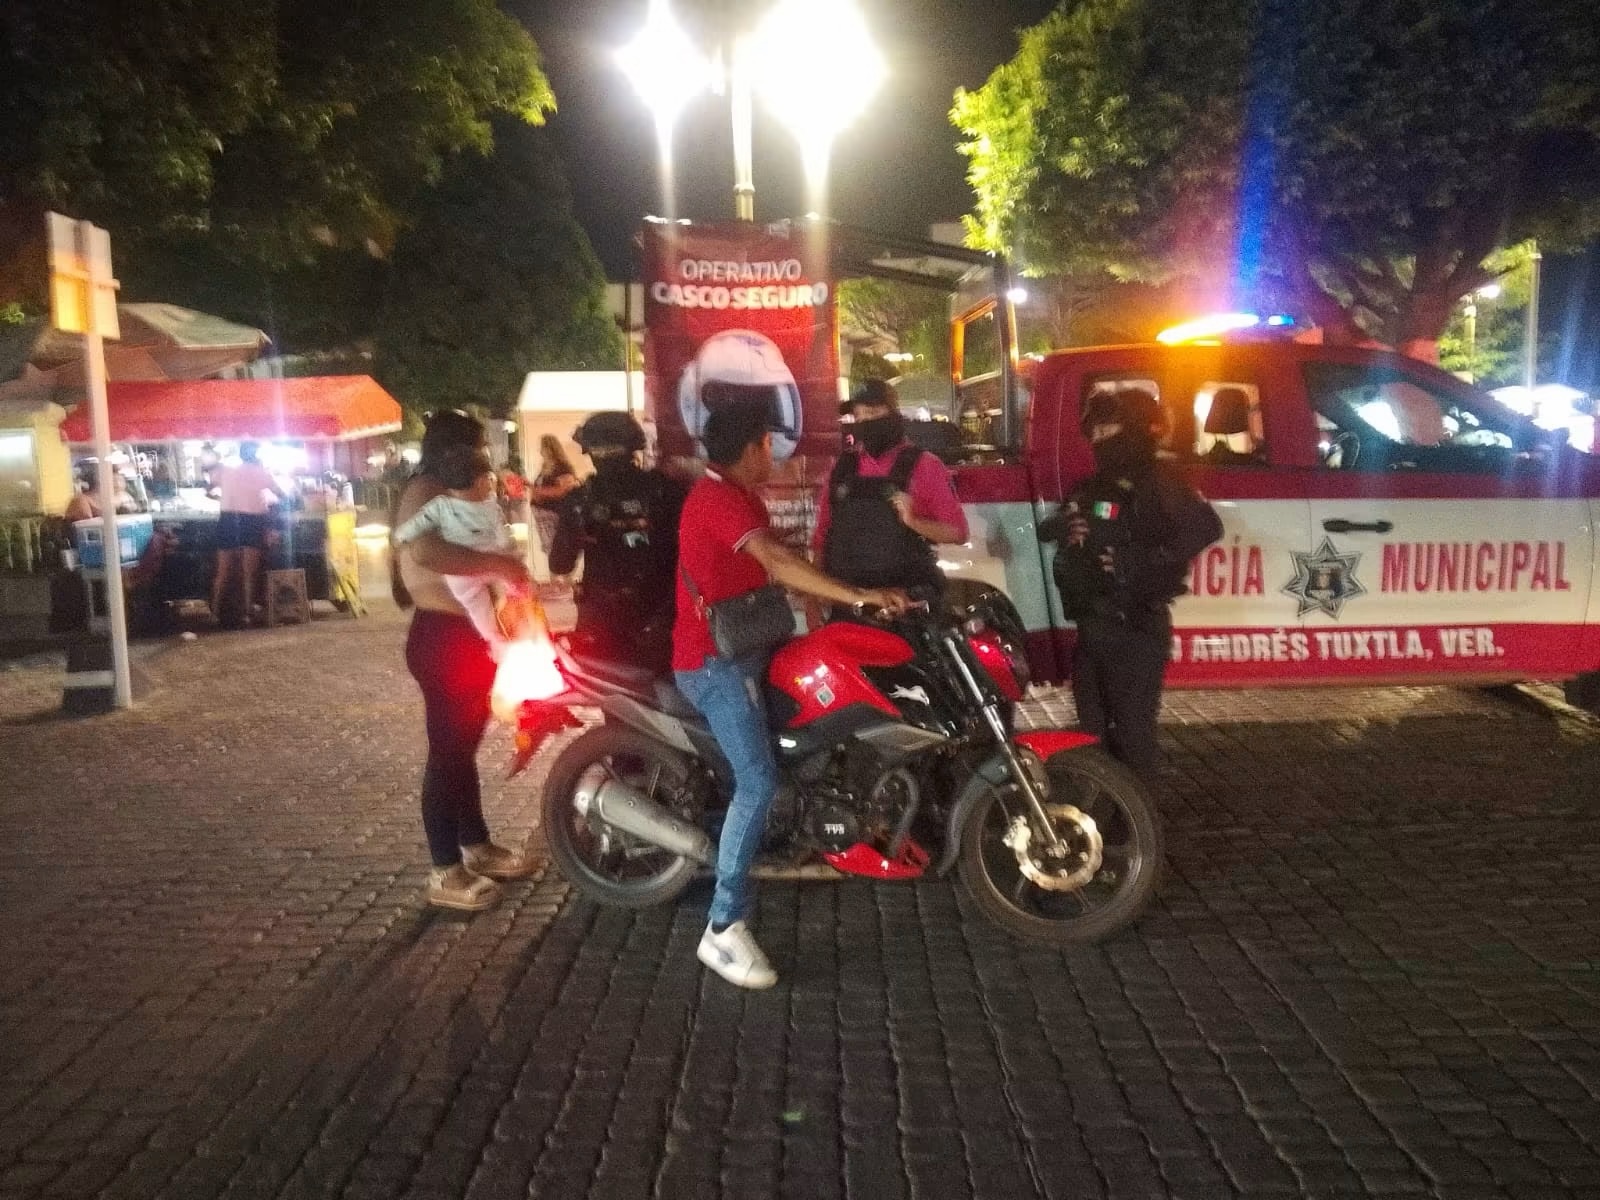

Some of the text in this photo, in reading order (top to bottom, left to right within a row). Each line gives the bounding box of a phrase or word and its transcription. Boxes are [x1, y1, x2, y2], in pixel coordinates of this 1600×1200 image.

[680, 258, 801, 283] OPERATIVO
[652, 281, 828, 309] CASCO SEGURO
[1190, 534, 1571, 597] ICÍA MUNICIPAL
[1191, 628, 1310, 662] ANDRÉS
[1315, 630, 1433, 661] TUXTLA,
[1438, 627, 1504, 657] VER.
